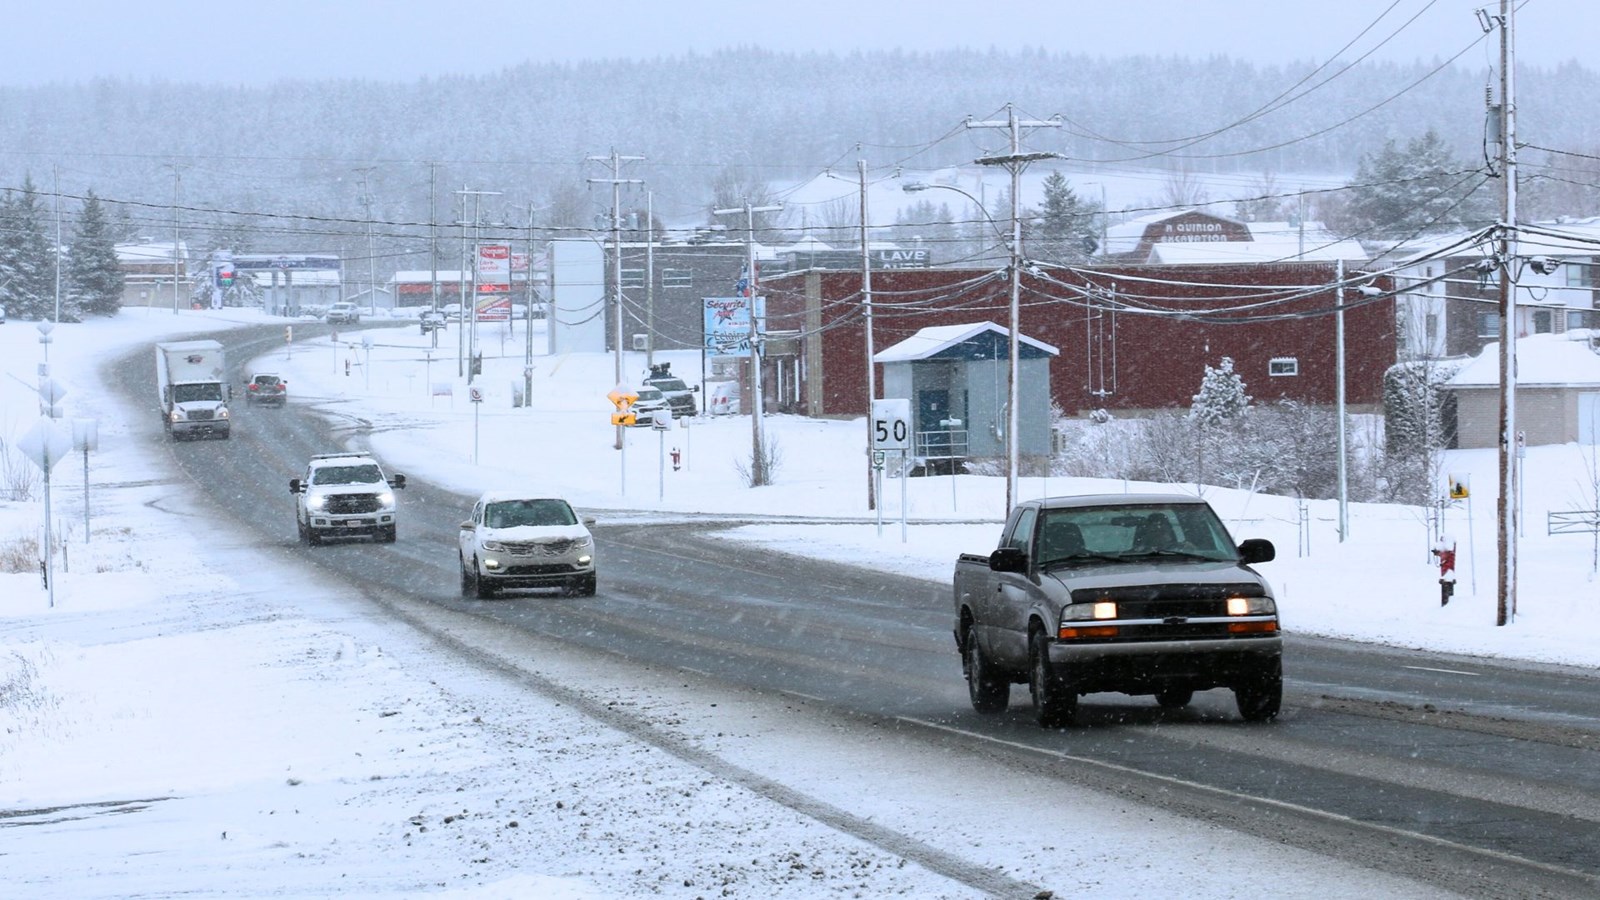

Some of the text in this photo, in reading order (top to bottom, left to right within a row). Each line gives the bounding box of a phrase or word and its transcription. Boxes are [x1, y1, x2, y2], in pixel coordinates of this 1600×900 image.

[1165, 222, 1222, 233] A QUIRION
[1160, 233, 1228, 243] EXCAVATION
[880, 250, 926, 261] LAVE
[876, 419, 906, 442] 50
